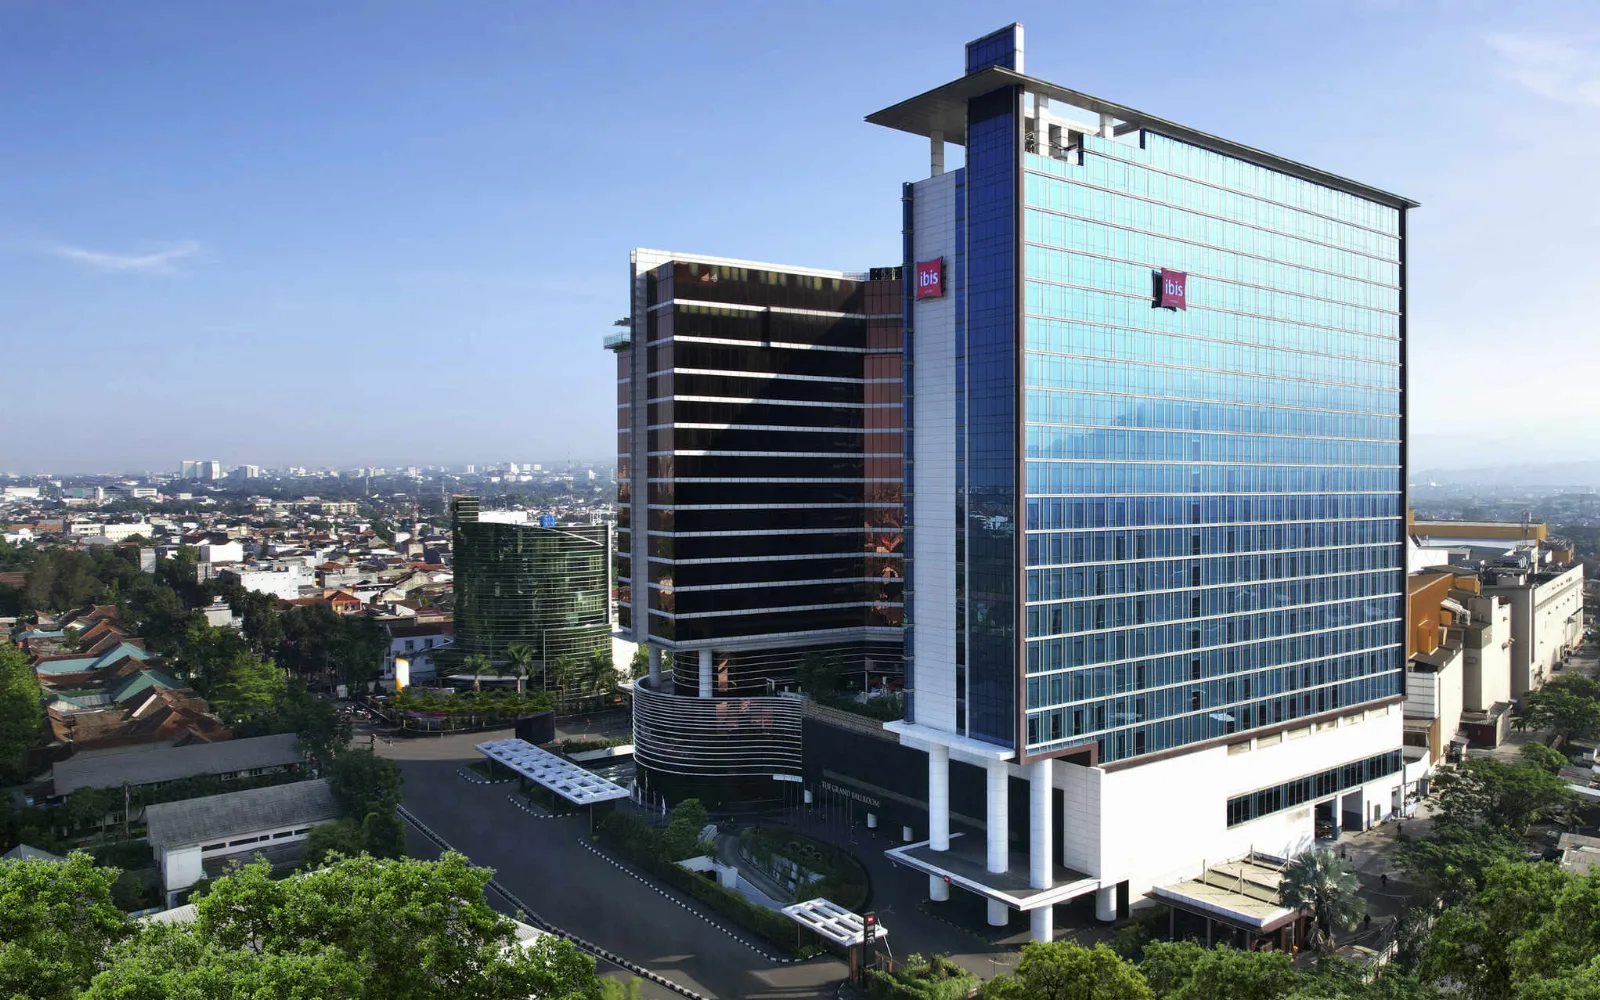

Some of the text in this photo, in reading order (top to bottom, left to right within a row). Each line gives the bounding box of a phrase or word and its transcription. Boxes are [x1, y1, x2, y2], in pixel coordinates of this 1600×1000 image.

[920, 270, 938, 287] ibis
[1165, 279, 1183, 297] ibis
[831, 785, 850, 797] GRAND
[851, 791, 880, 808] BALLROOM
